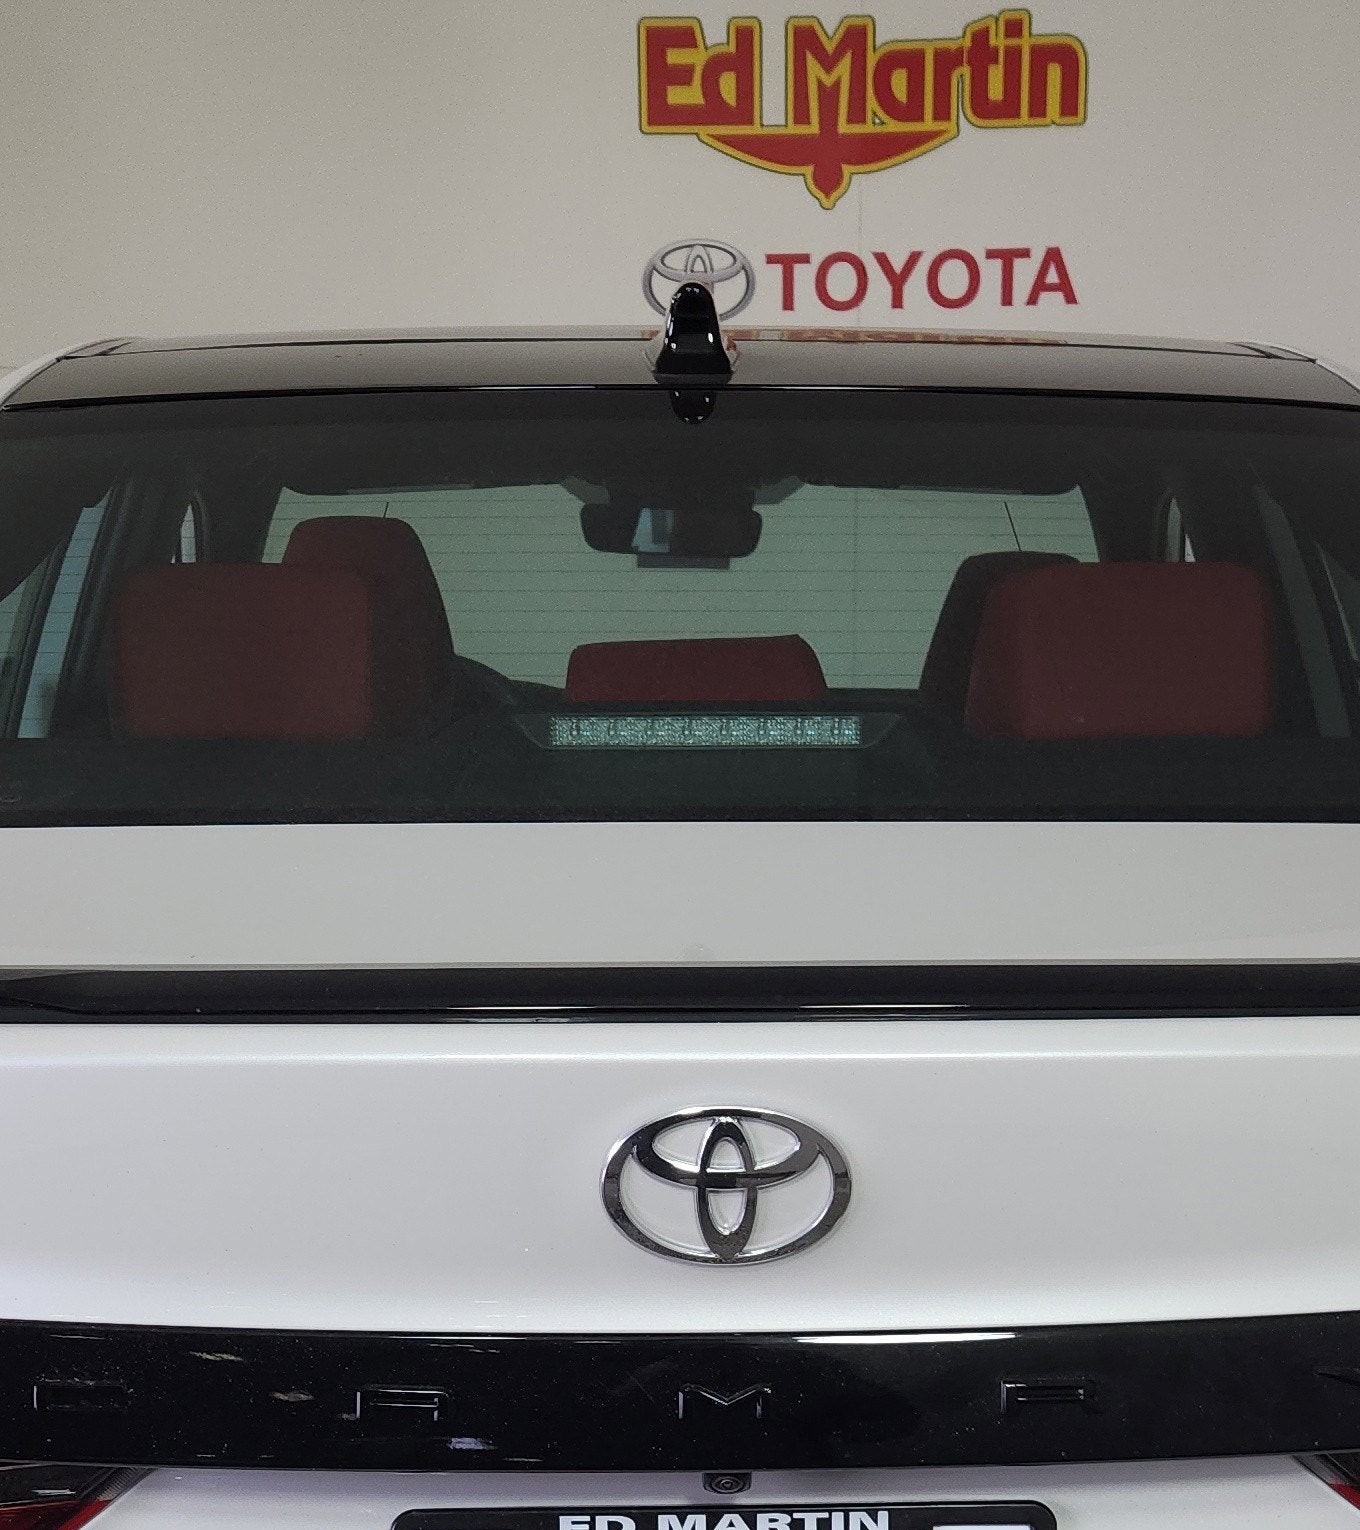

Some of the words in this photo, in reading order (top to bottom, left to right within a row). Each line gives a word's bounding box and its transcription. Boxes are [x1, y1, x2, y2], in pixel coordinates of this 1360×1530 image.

[641, 18, 760, 131] Ed
[786, 11, 1086, 127] Martin
[765, 246, 1079, 312] TOYOTA
